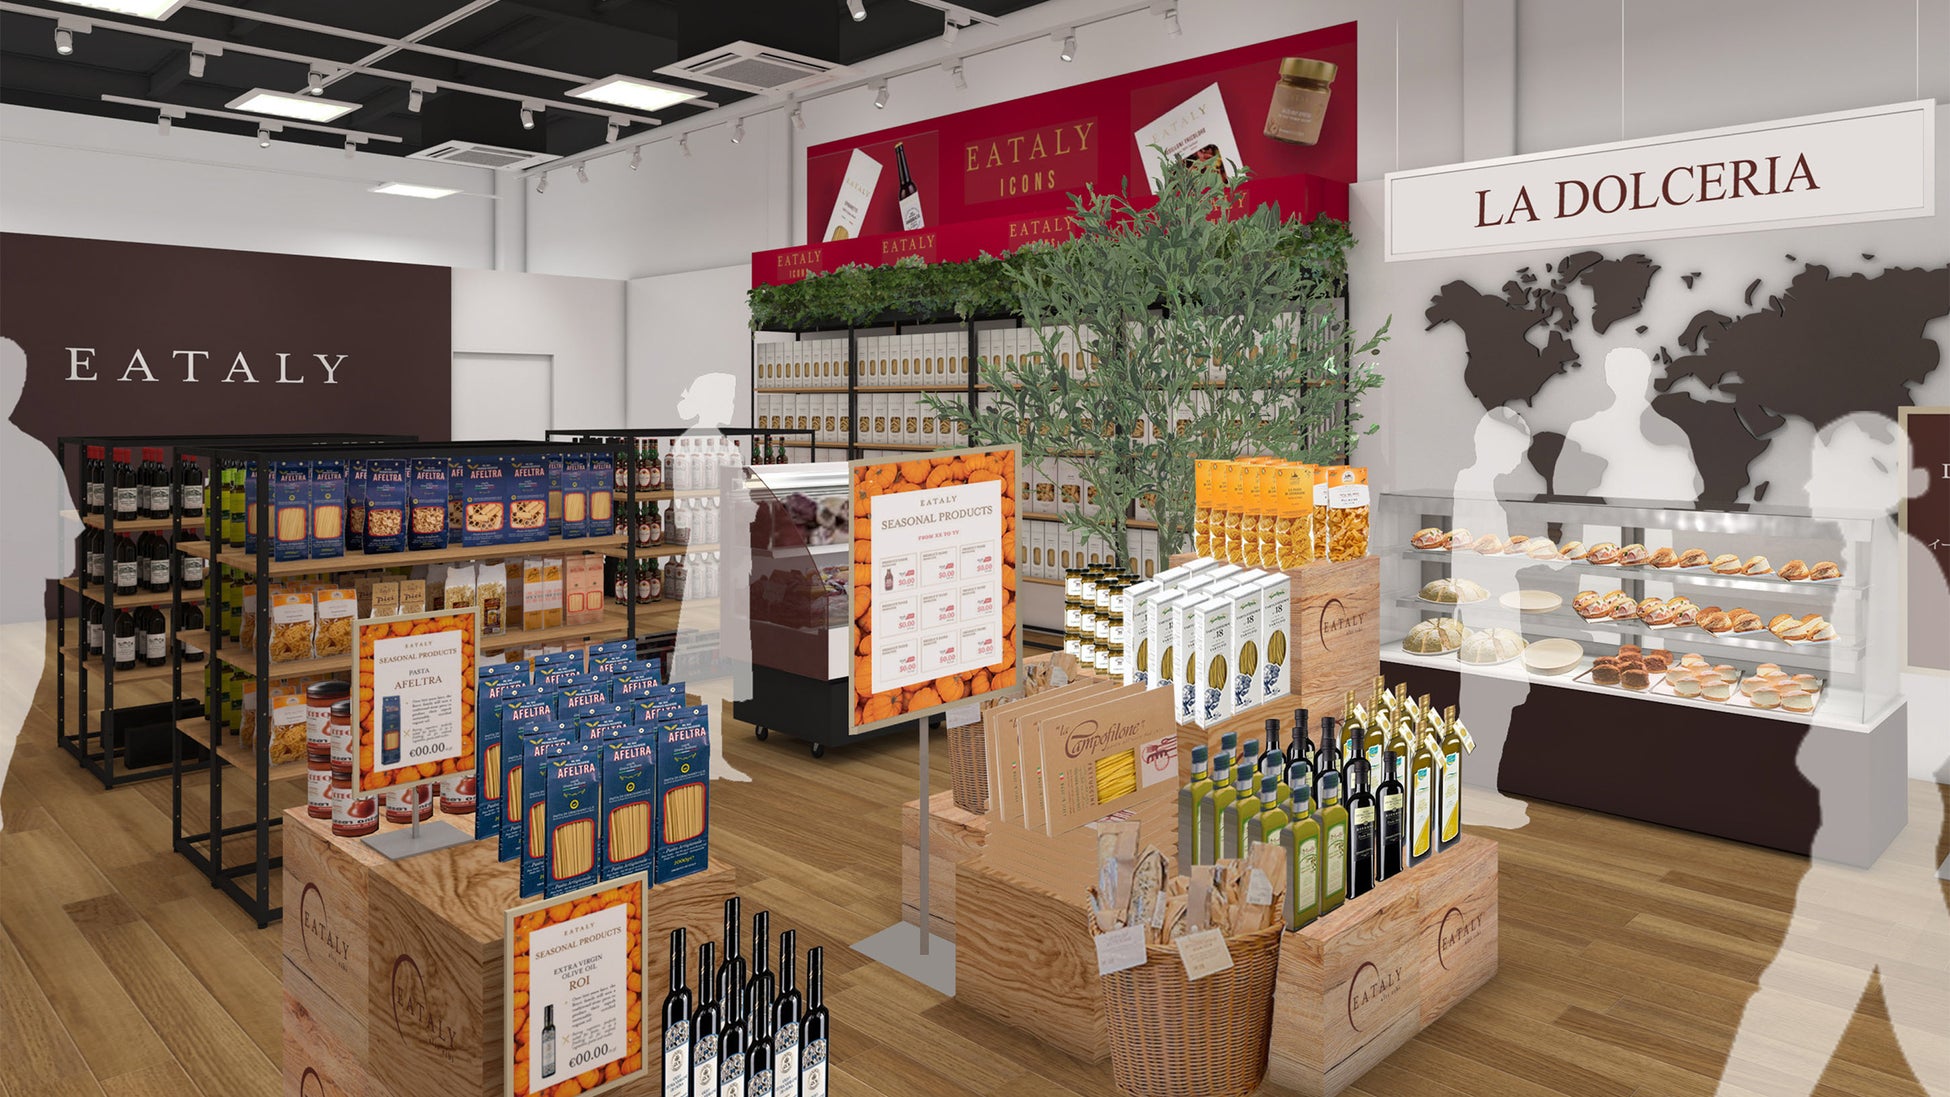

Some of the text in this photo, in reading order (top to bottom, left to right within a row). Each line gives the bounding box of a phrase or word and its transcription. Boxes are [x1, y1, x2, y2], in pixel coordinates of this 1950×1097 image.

[966, 122, 1095, 173] EATALY
[999, 169, 1056, 198] ICONS
[1475, 153, 1820, 228] LA DOLCERIA
[1010, 216, 1073, 238] EATALY
[882, 234, 935, 253] EATALY
[777, 249, 822, 267] EATALY
[789, 268, 806, 279] ICON
[65, 346, 349, 384] EATALY
[281, 473, 307, 482] AFELTRA
[317, 473, 342, 481] AFELTRA
[373, 473, 402, 482] AFELTRA
[417, 471, 445, 480] AFELTRA
[470, 468, 502, 480] AFELTRA
[514, 467, 545, 477] AFELTRA
[920, 495, 958, 507] EATALY
[881, 504, 993, 530] SEASONAL PRODUCTS
[1323, 613, 1364, 633] EATALY
[378, 647, 458, 665] SEASONAL PRODUCTS
[408, 668, 431, 676] PASTA
[394, 675, 443, 690] AFELTRA
[568, 692, 605, 708] AFELTRA
[512, 704, 551, 721] AFELTRA
[668, 727, 707, 743] AFELTRA
[409, 742, 446, 758] €00.00
[613, 745, 652, 762] AFELTRA
[557, 763, 596, 779] AFELTRA
[304, 910, 350, 960] EATALY
[563, 922, 596, 937] EATALY
[1442, 913, 1483, 952] EATALY
[535, 926, 622, 960] SEASONAL PRODUCTS
[553, 953, 603, 976] EXTRA VIRGIN
[561, 963, 598, 981] OLIVE OIL
[568, 975, 591, 991] ROI
[1352, 967, 1403, 1011] EATALY
[396, 986, 457, 1050] EATALY
[569, 1043, 609, 1069] €00.00
